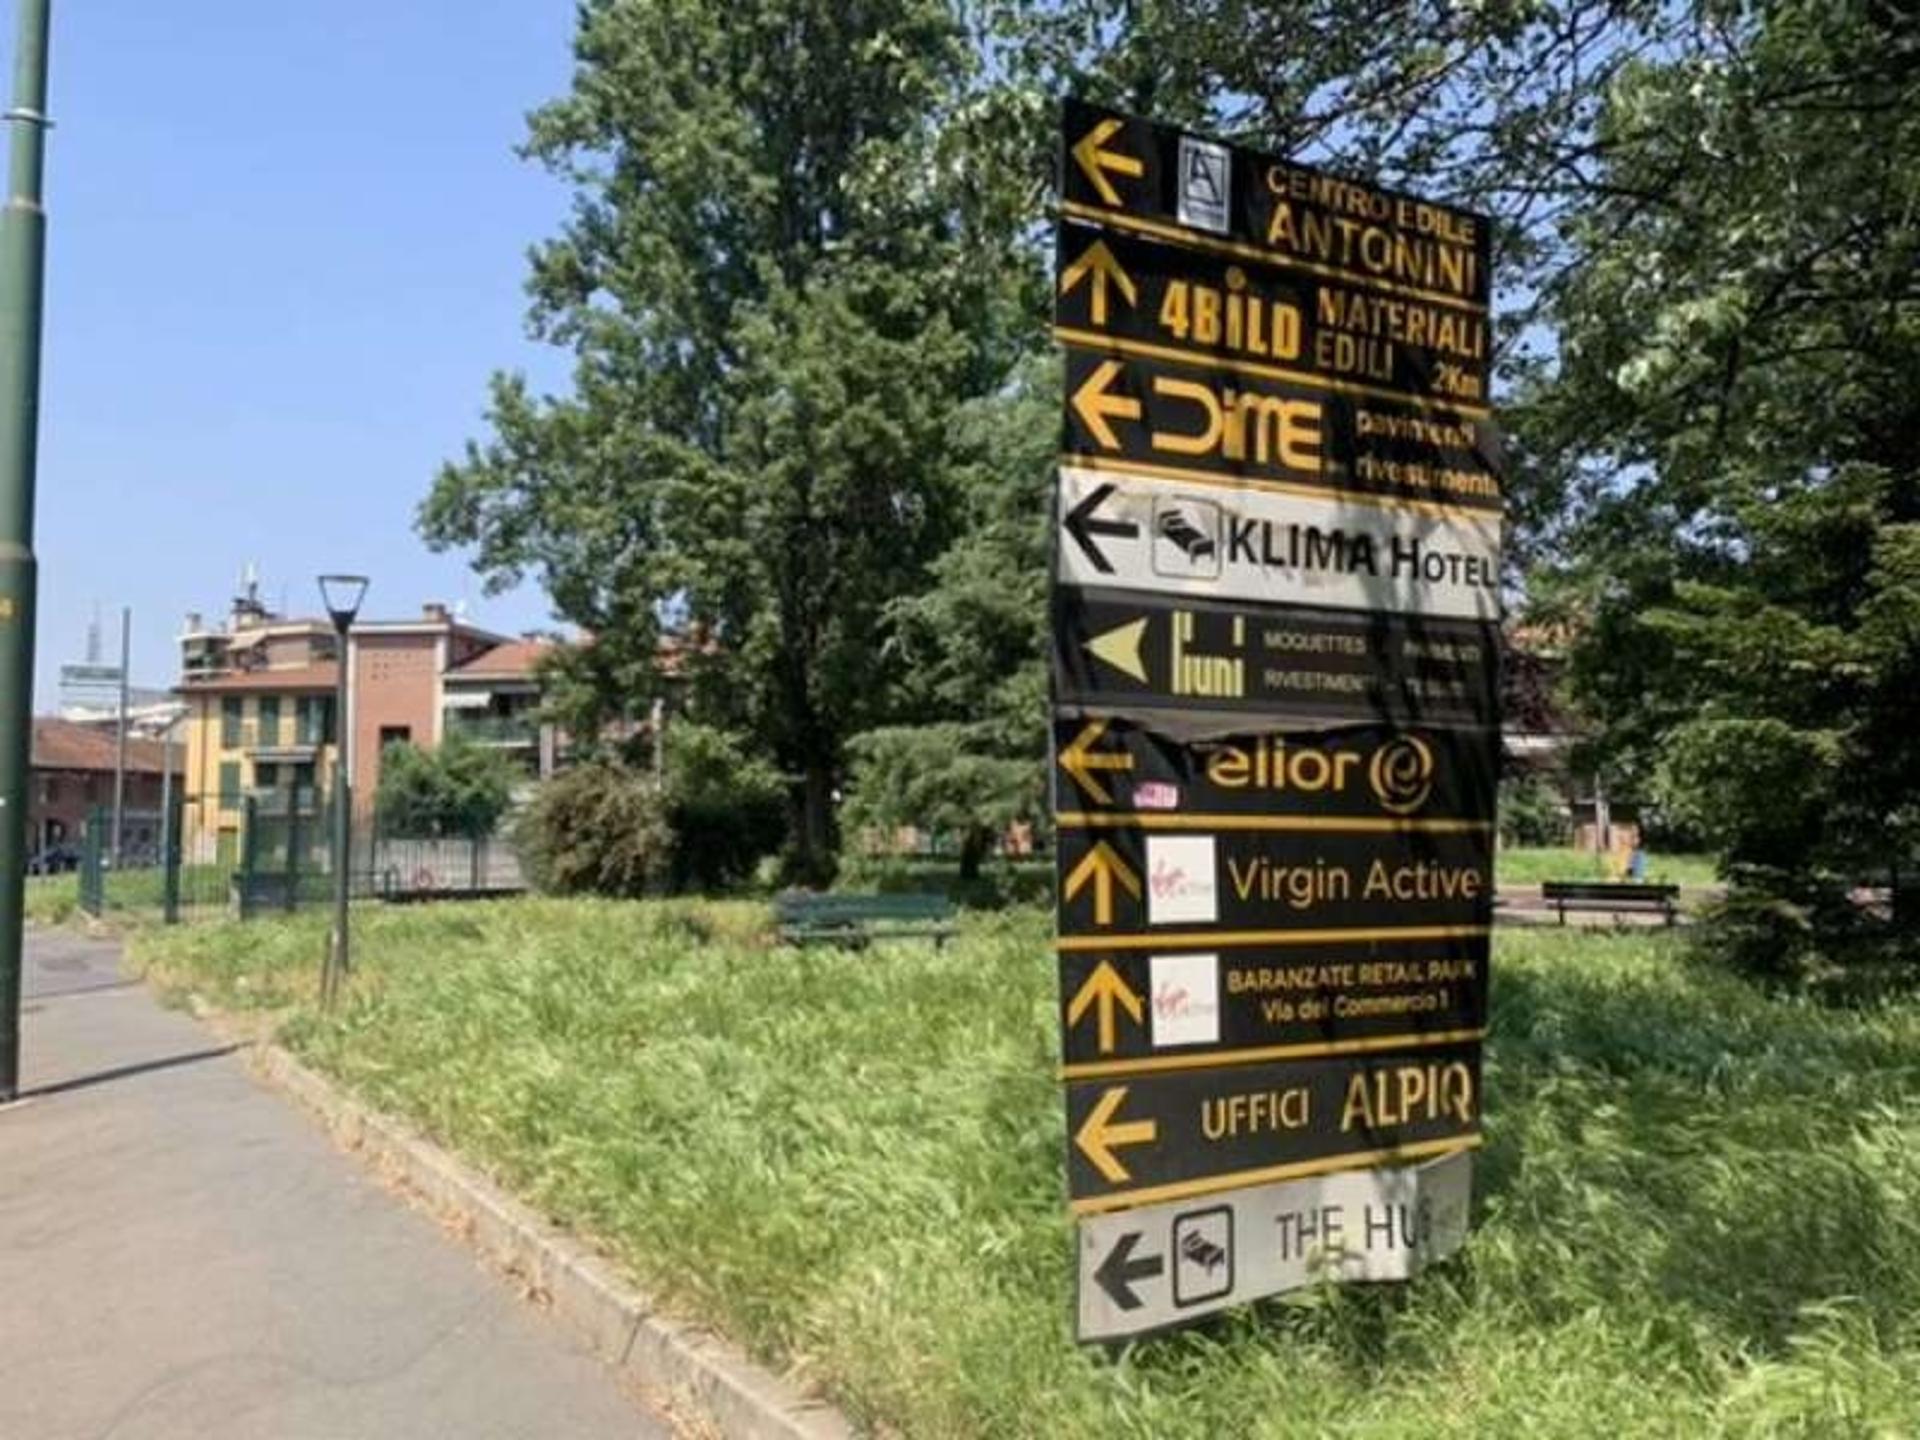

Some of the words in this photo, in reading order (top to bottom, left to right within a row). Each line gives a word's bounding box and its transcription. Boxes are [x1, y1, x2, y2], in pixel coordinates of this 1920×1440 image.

[1267, 165, 1390, 221] CENTRO
[1397, 200, 1476, 246] EDILE
[1268, 202, 1476, 295] ANTONINI
[1317, 287, 1483, 358] MATERIALI
[1315, 330, 1394, 382] EDILI
[1227, 515, 1376, 578] KLIMA
[1263, 631, 1367, 655] MOQUETTES
[1208, 737, 1361, 791] elior
[1227, 856, 1350, 908] Virgin
[1363, 857, 1481, 900] Active
[1227, 965, 1354, 993] BARANZATE
[1358, 961, 1423, 985] RETAIL
[1262, 999, 1294, 1023] Via
[1202, 1088, 1310, 1141] UFFICI
[1341, 1062, 1471, 1133] ALPIQ
[1275, 1205, 1343, 1262] THE
